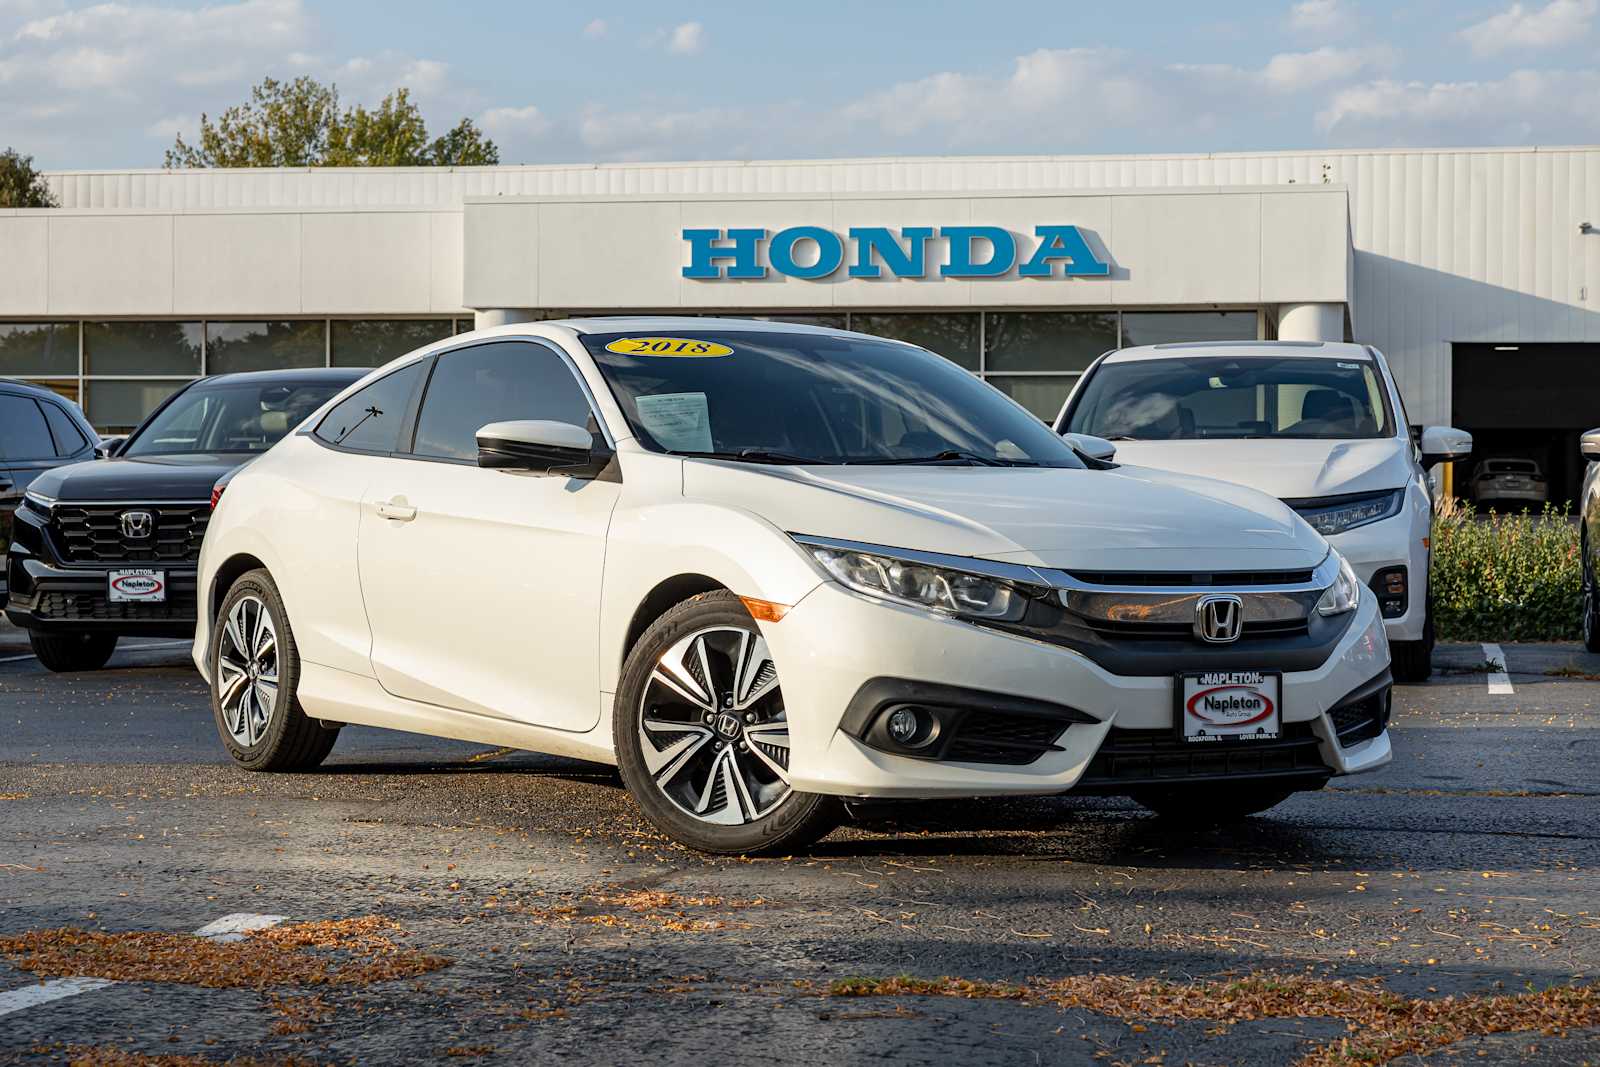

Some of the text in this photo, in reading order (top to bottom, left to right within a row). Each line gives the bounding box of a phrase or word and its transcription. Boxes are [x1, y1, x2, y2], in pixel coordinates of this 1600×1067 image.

[682, 225, 1110, 279] HONDA
[631, 341, 711, 353] 2018
[122, 580, 155, 588] Napleton
[1204, 672, 1260, 684] NAPLETON
[1204, 695, 1260, 712] Napleton
